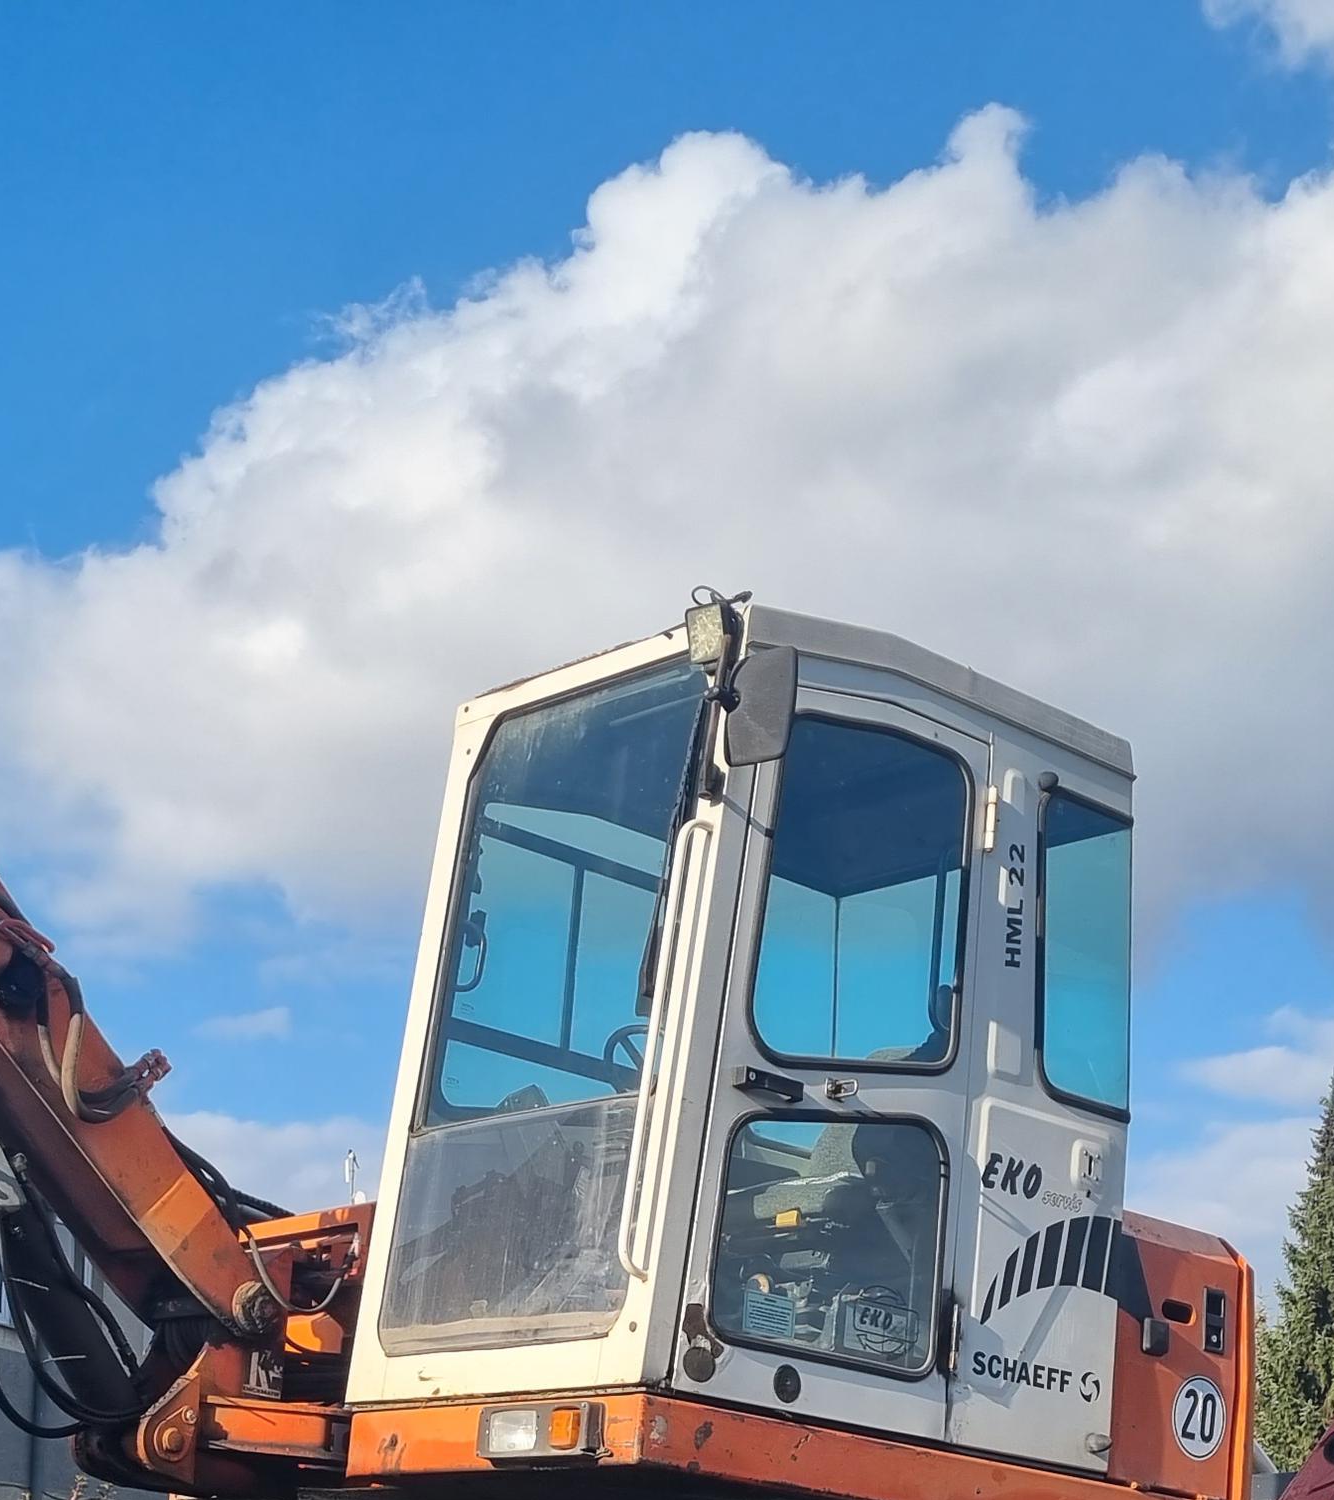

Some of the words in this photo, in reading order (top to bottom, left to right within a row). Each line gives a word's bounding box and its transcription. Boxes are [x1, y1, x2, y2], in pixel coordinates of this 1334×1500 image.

[1008, 843, 1025, 887] 22
[1004, 899, 1023, 968] HML
[981, 1152, 1043, 1200] EKO
[1042, 1190, 1083, 1213] servis
[972, 1351, 1072, 1393] SCHAEFF
[1181, 1388, 1217, 1444] 20
